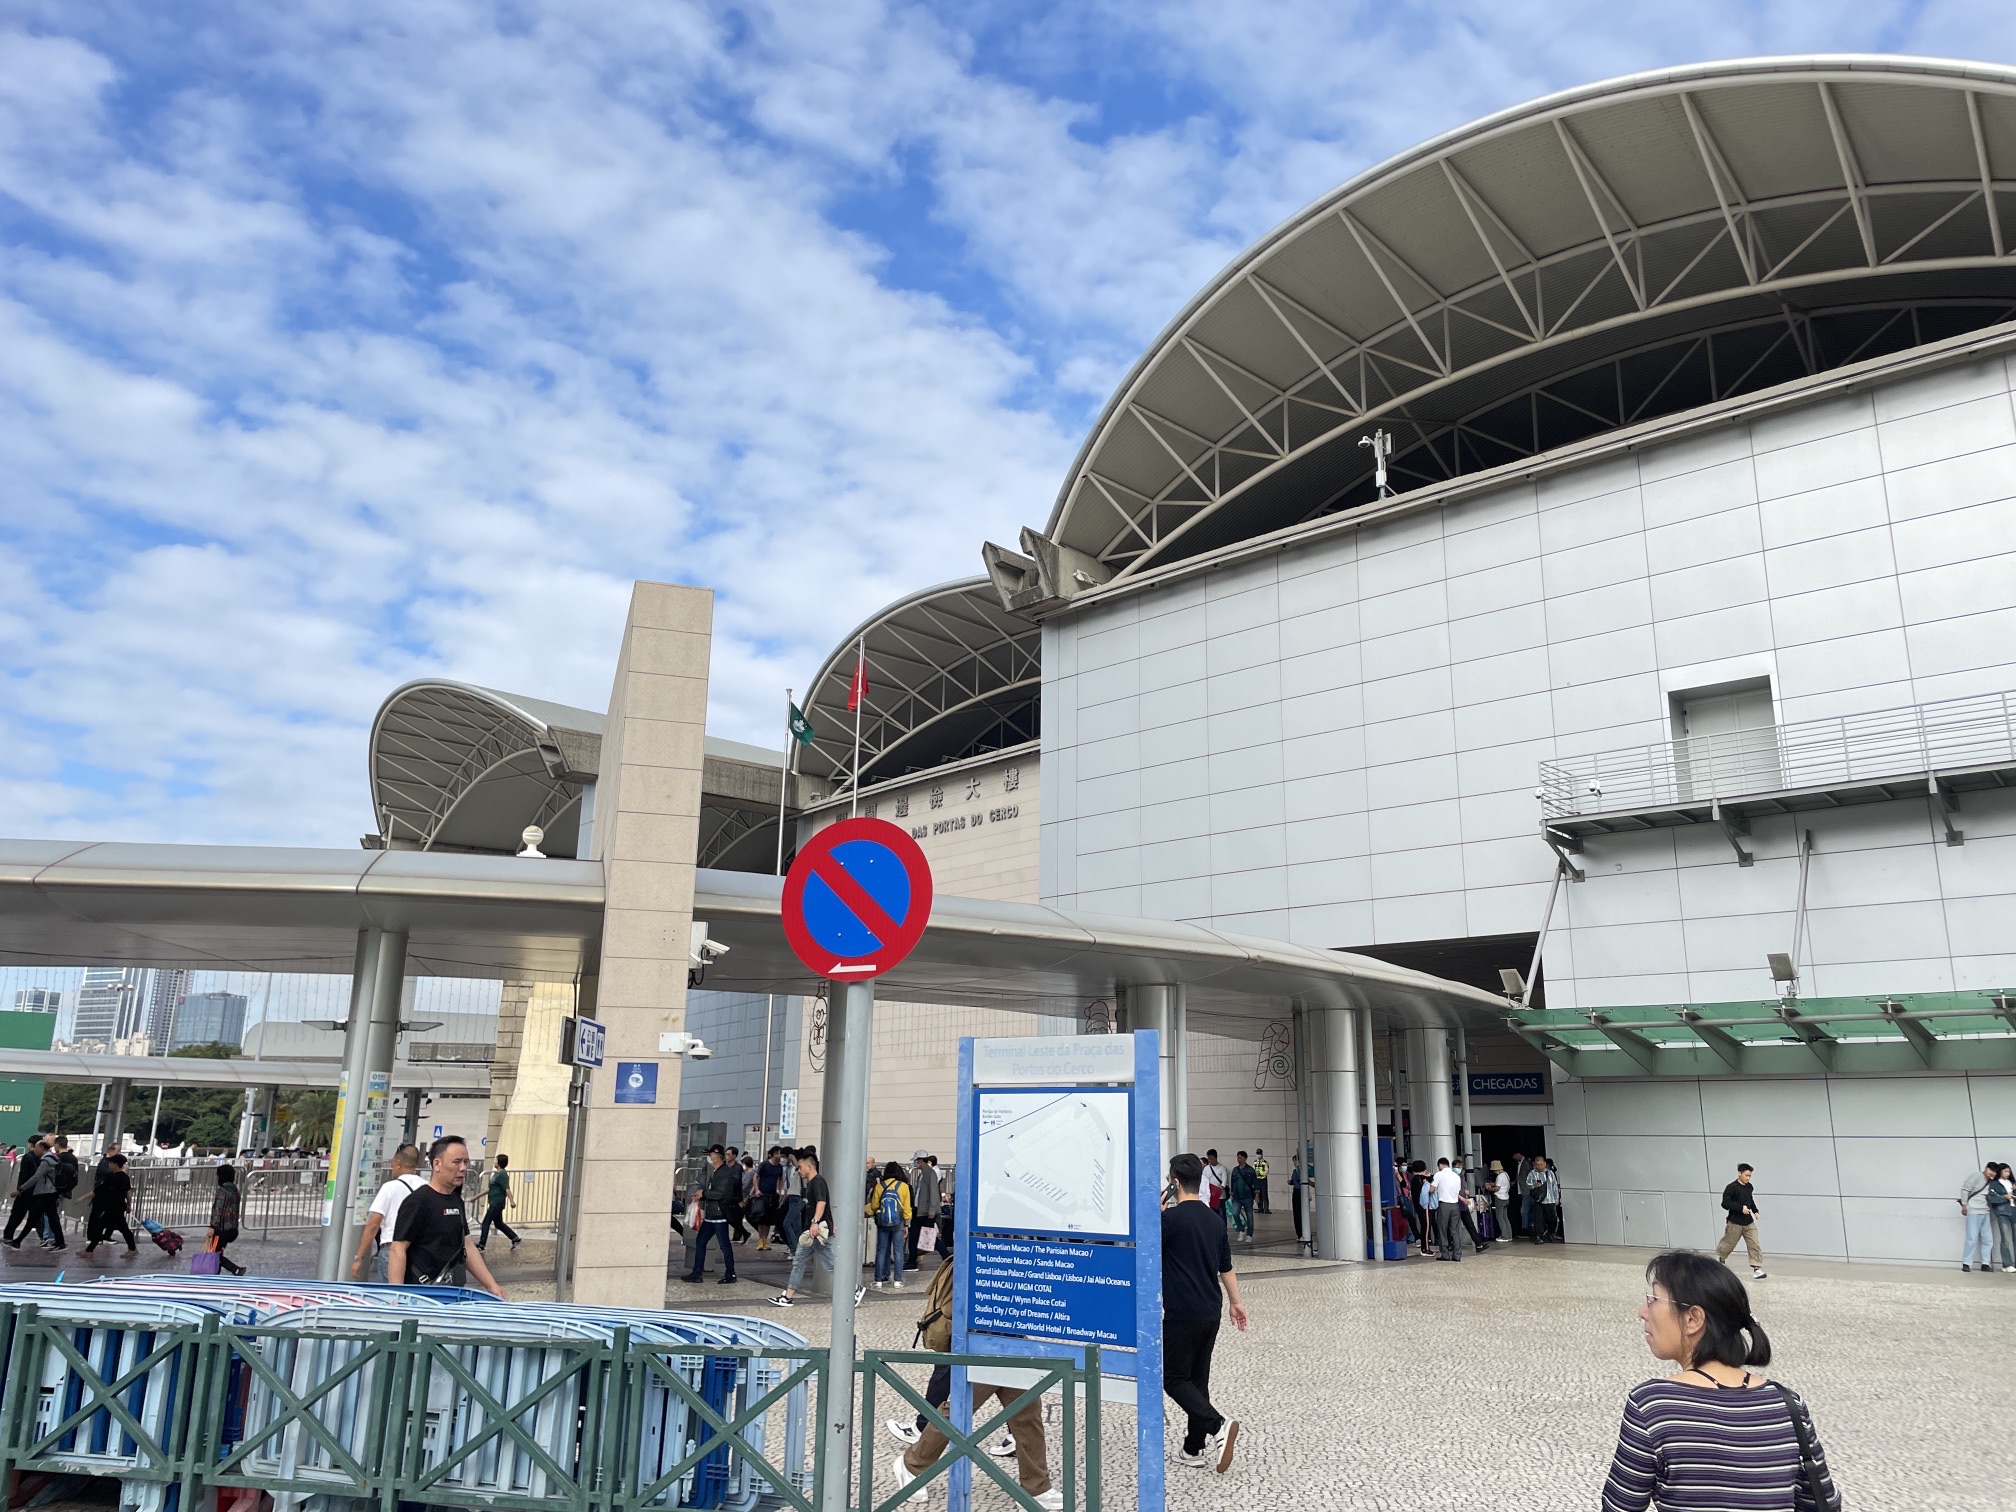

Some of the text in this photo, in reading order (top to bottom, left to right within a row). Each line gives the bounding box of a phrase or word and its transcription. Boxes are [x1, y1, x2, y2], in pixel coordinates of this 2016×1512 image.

[912, 805, 1019, 839] DAS PORTAS DO CERCO
[984, 1045, 1025, 1058] Terminal
[1029, 1045, 1055, 1057] Leste
[1074, 1044, 1102, 1058] Praça
[1106, 1042, 1124, 1055] das
[1013, 1062, 1094, 1076] Portas do Cerco
[1472, 1078, 1537, 1090] CHEGADAS
[987, 1243, 1010, 1251] Venetian
[1012, 1245, 1030, 1253] Macao
[1046, 1247, 1068, 1255] Parisian
[1069, 1248, 1089, 1256] Macao
[976, 1254, 986, 1262] The
[987, 1255, 1013, 1264] Londoner
[1014, 1257, 1032, 1265] Macao
[1037, 1259, 1054, 1267] Sands
[1055, 1260, 1074, 1268] Macao
[976, 1267, 991, 1275] Grand
[992, 1268, 1007, 1276] Lisboa
[1008, 1269, 1024, 1277] Palace
[1028, 1271, 1044, 1279] Grand
[1045, 1272, 1061, 1280] Lisboa
[1066, 1274, 1083, 1283] Lisboa
[1095, 1276, 1105, 1285] Alai
[1106, 1277, 1130, 1286] Oceanus
[976, 1279, 990, 1287] MGM
[992, 1281, 1013, 1289] MACAU
[1018, 1283, 1033, 1291] MGM
[1034, 1285, 1052, 1293] COTAI
[975, 1292, 991, 1301] Wynn
[992, 1293, 1010, 1302] Macau
[1014, 1296, 1031, 1305] Wynn
[1032, 1297, 1050, 1306] Palace
[1051, 1299, 1066, 1307] Cotai
[975, 1304, 992, 1313] Studio
[993, 1306, 1004, 1316] City
[1008, 1308, 1019, 1317] City
[1027, 1309, 1049, 1319] Dreams
[1054, 1312, 1070, 1321] Altira
[975, 1317, 993, 1327] Galaxy
[993, 1319, 1012, 1328] Macau
[1017, 1321, 1044, 1332] StarWorld
[1046, 1324, 1061, 1333] Hotel
[1067, 1327, 1096, 1339] Broadway
[1097, 1330, 1117, 1339] Macau
